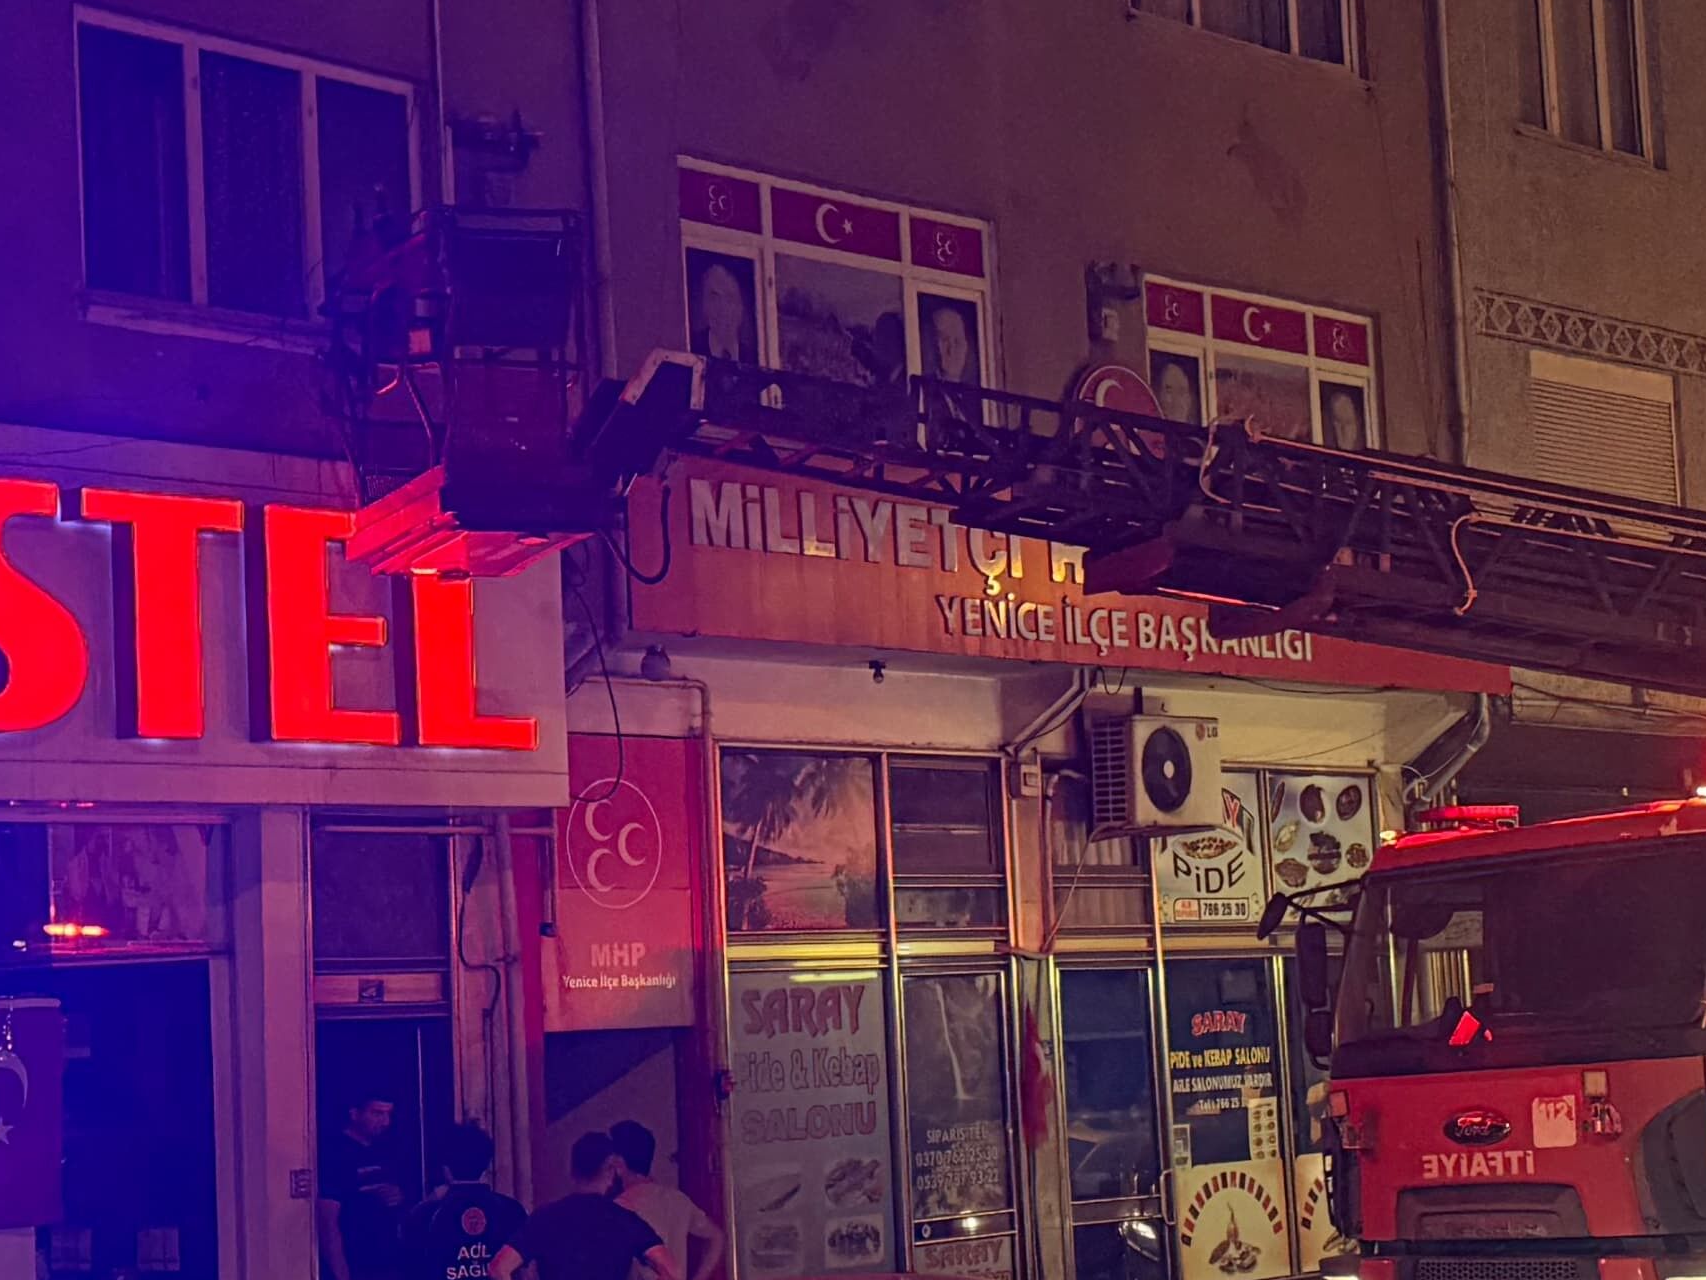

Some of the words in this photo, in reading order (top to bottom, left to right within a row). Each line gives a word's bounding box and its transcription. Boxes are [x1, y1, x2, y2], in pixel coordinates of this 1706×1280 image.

[938, 593, 1055, 642] YENİCE
[1064, 597, 1129, 657] İLÇE
[591, 942, 646, 967] MHP
[563, 975, 597, 989] Yenice
[741, 984, 865, 1039] SARAY
[1192, 1010, 1246, 1036] SARAY
[792, 1050, 809, 1090] &
[812, 1047, 881, 1095] Kebap
[1204, 1048, 1233, 1067] KEBAP
[1235, 1046, 1270, 1065] SALONU
[742, 1101, 876, 1145] SALONU
